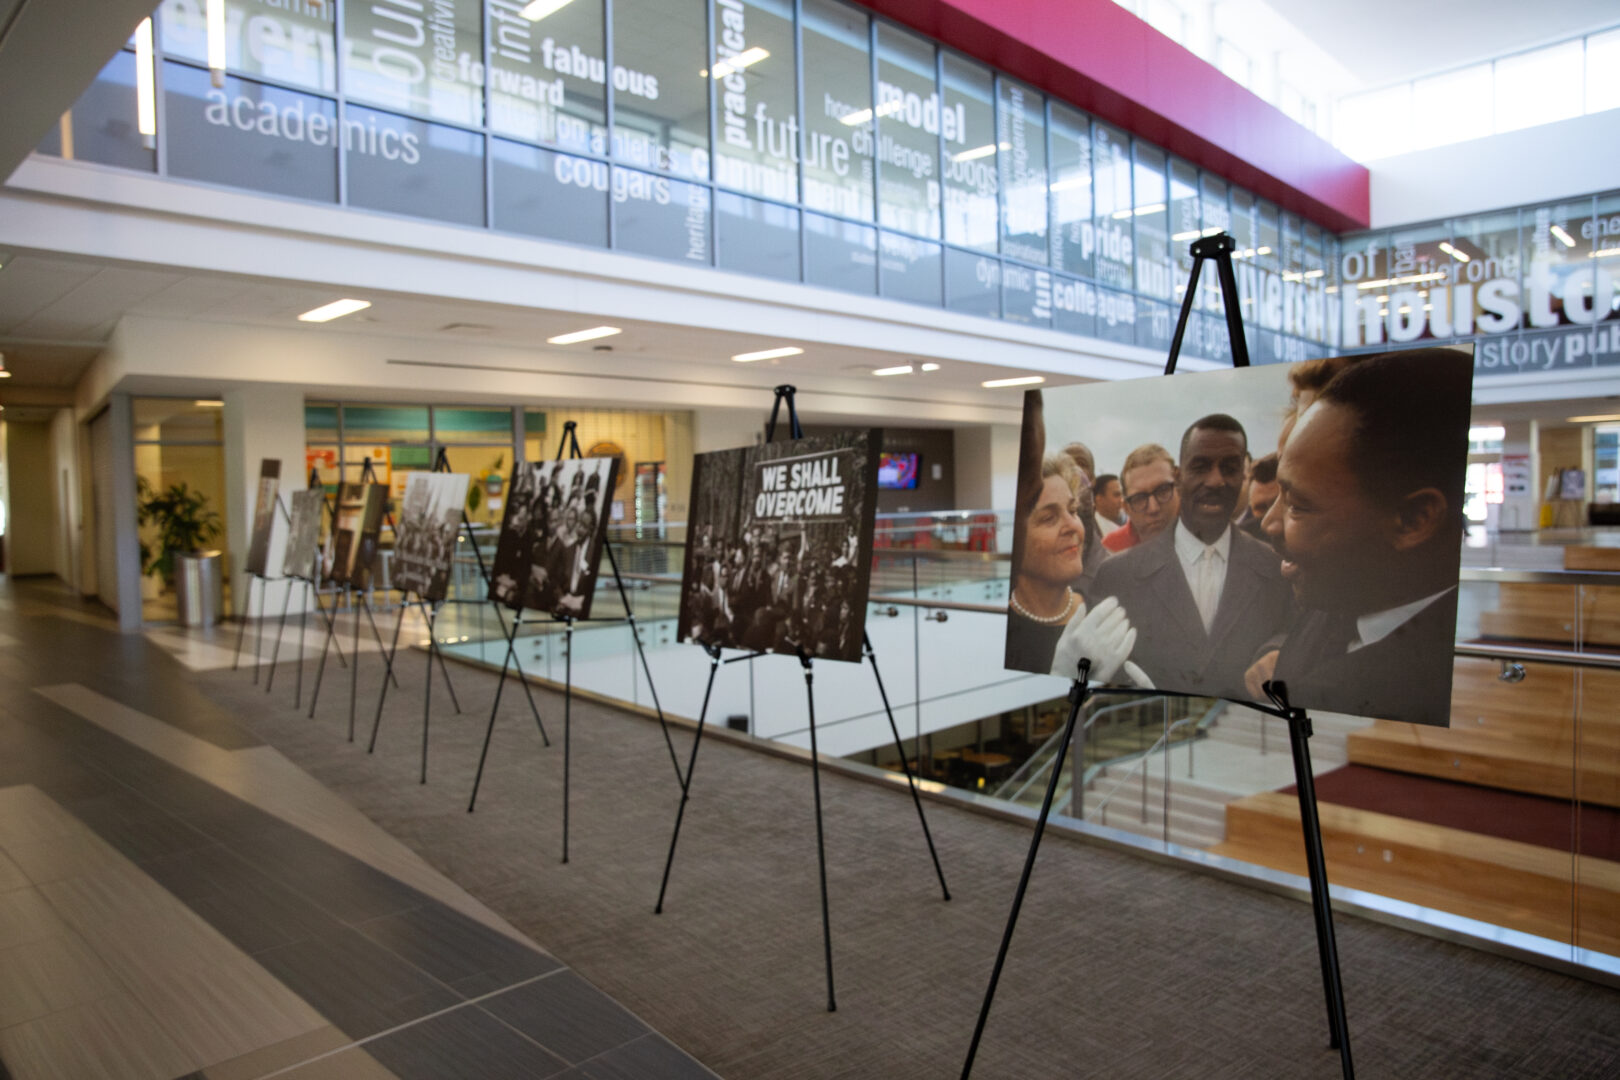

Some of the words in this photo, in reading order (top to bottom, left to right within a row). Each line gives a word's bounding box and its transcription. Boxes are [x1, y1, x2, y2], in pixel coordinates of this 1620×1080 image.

[457, 52, 564, 107] forward
[540, 38, 659, 100] fabuous
[717, 0, 752, 149] pracical
[205, 89, 421, 164] academics
[877, 80, 966, 144] model
[591, 125, 680, 172] ahletics
[754, 102, 849, 176] future
[554, 154, 671, 206] cougars
[1081, 217, 1133, 265] pride
[1343, 241, 1379, 282] of
[976, 259, 1031, 292] dynmic
[1467, 255, 1519, 283] one
[1475, 335, 1561, 369] istory
[762, 465, 788, 491] WE
[790, 457, 842, 489] SHALL
[755, 486, 845, 518] OVERCOME
